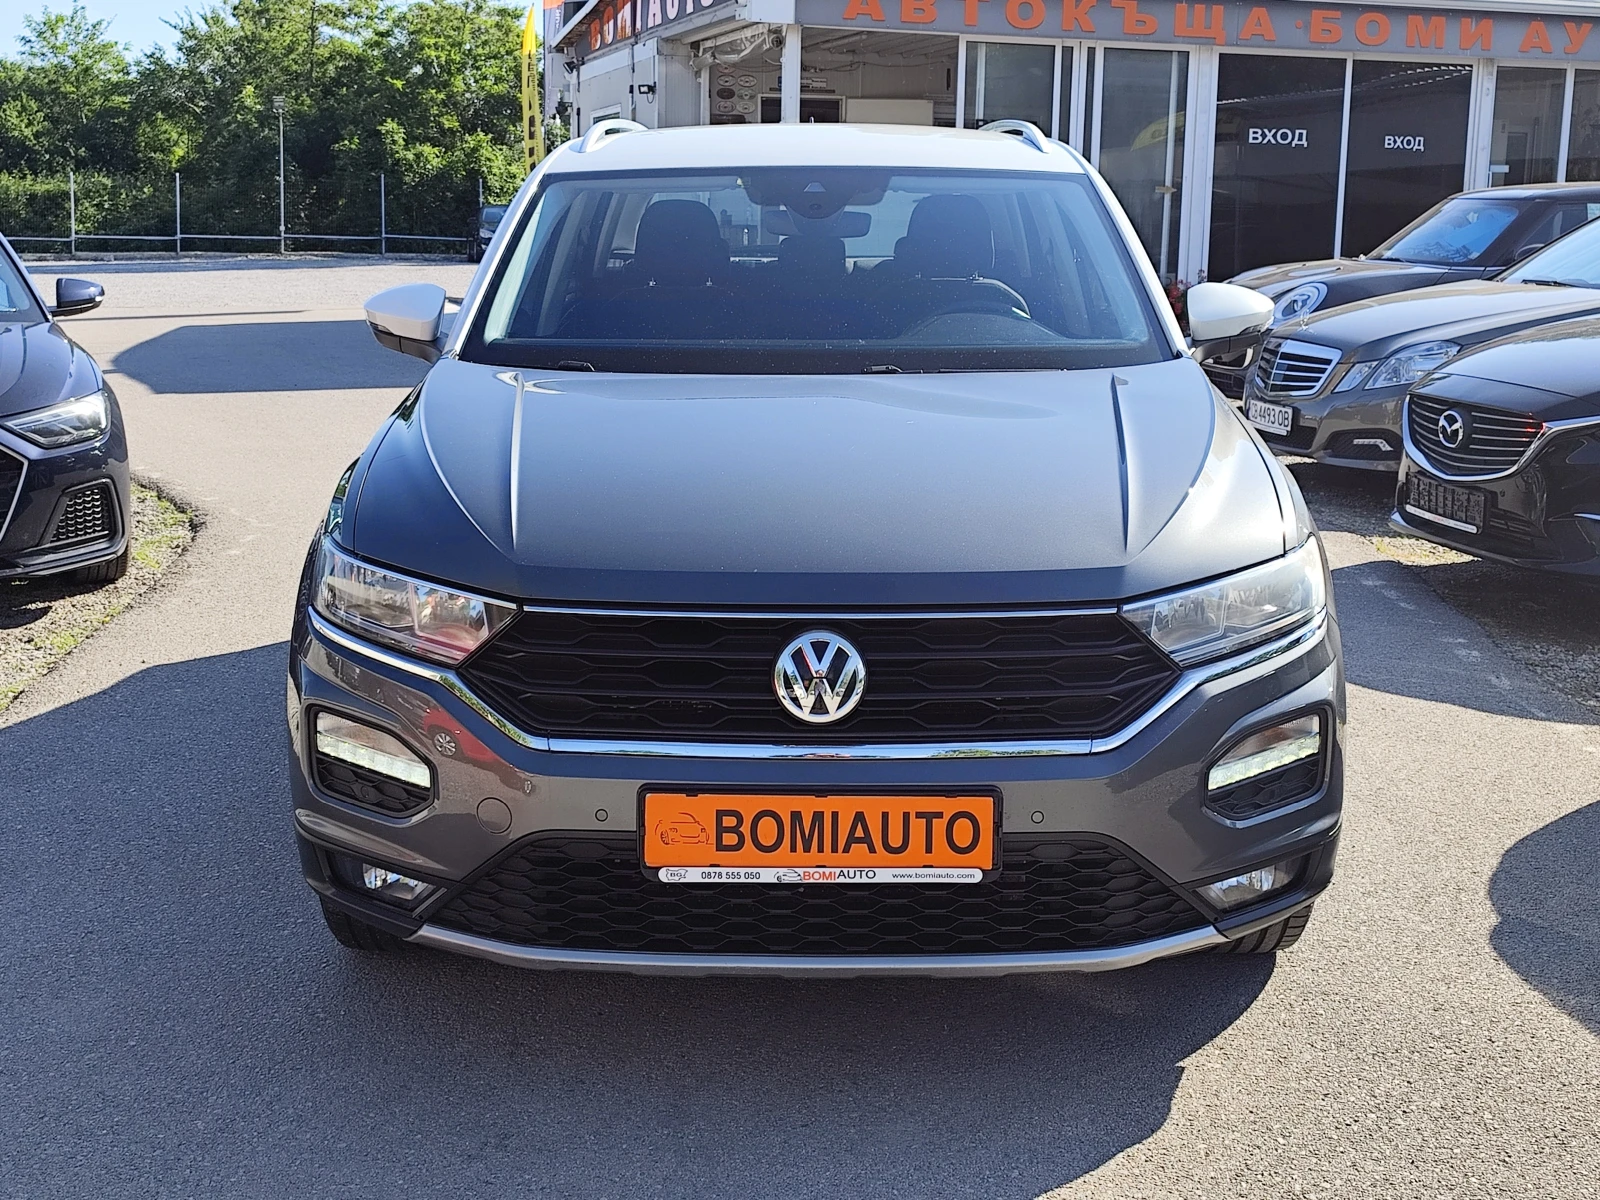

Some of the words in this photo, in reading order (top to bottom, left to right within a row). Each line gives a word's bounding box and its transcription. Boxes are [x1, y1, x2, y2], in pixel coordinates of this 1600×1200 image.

[842, 0, 1277, 46] АВТОКЪЩА
[1309, 9, 1493, 51] БОМИ
[1248, 128, 1308, 147] ВХОД
[1384, 135, 1424, 151] ВХОД
[715, 809, 981, 855] BOMIAUTO
[701, 871, 723, 880] 0878
[725, 871, 742, 880] 555
[744, 871, 761, 880] 050
[891, 872, 976, 880] www.bomiauto.com
